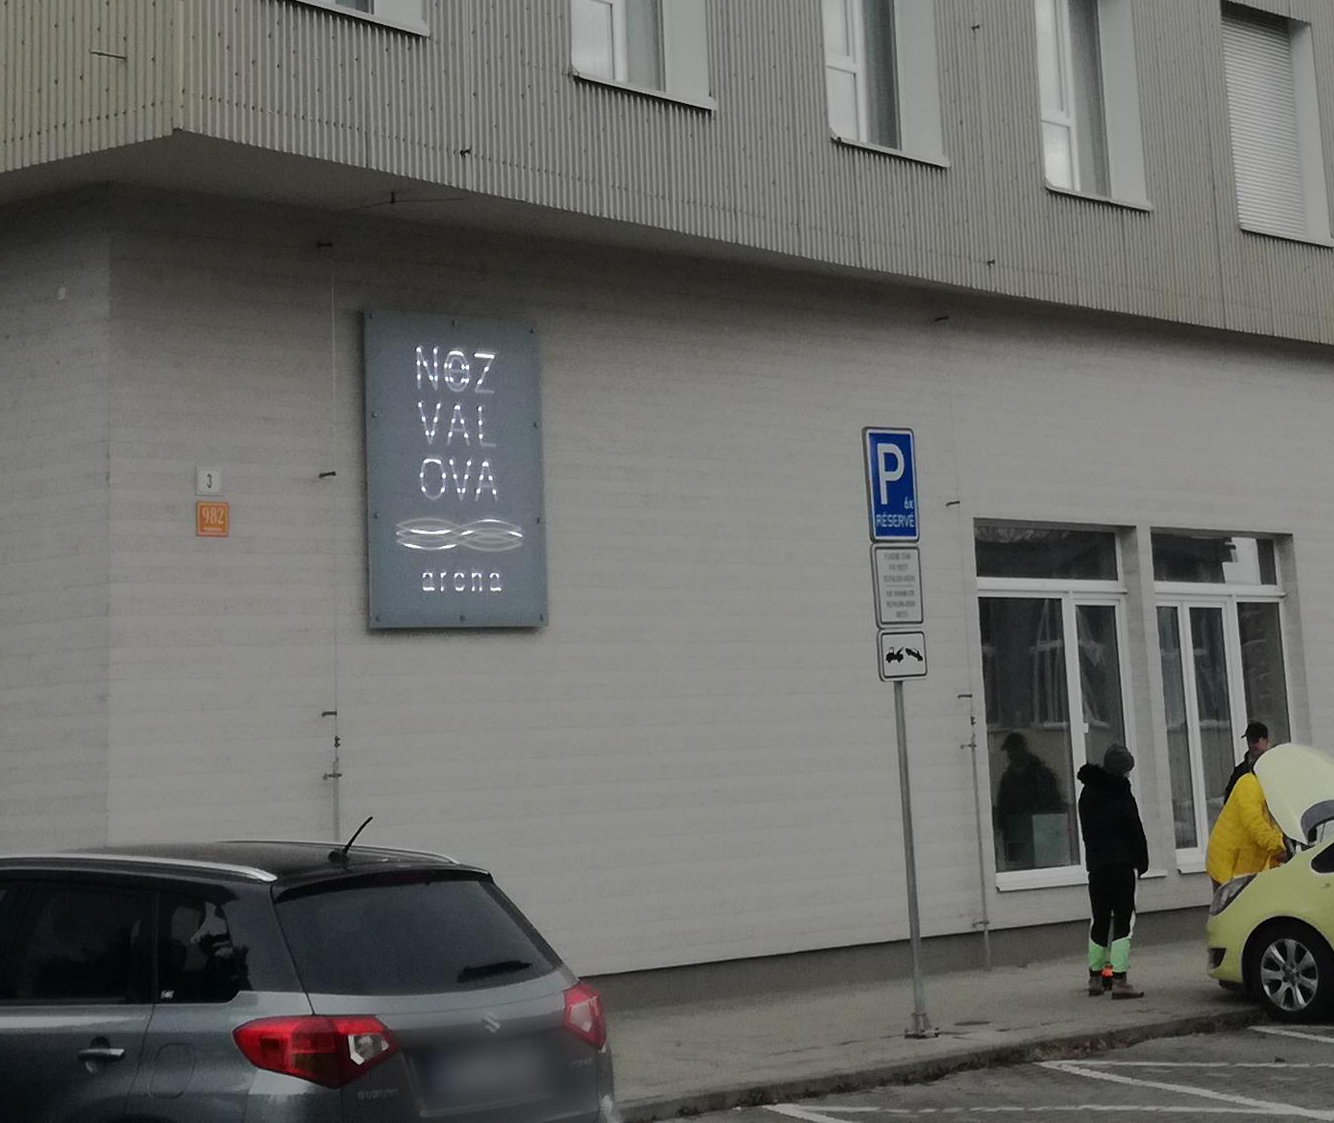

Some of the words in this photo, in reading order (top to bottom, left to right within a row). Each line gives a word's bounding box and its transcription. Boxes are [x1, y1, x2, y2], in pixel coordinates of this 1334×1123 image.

[417, 400, 498, 448] VAL
[419, 457, 500, 503] OVA
[876, 442, 906, 506] P
[421, 570, 502, 592] arena
